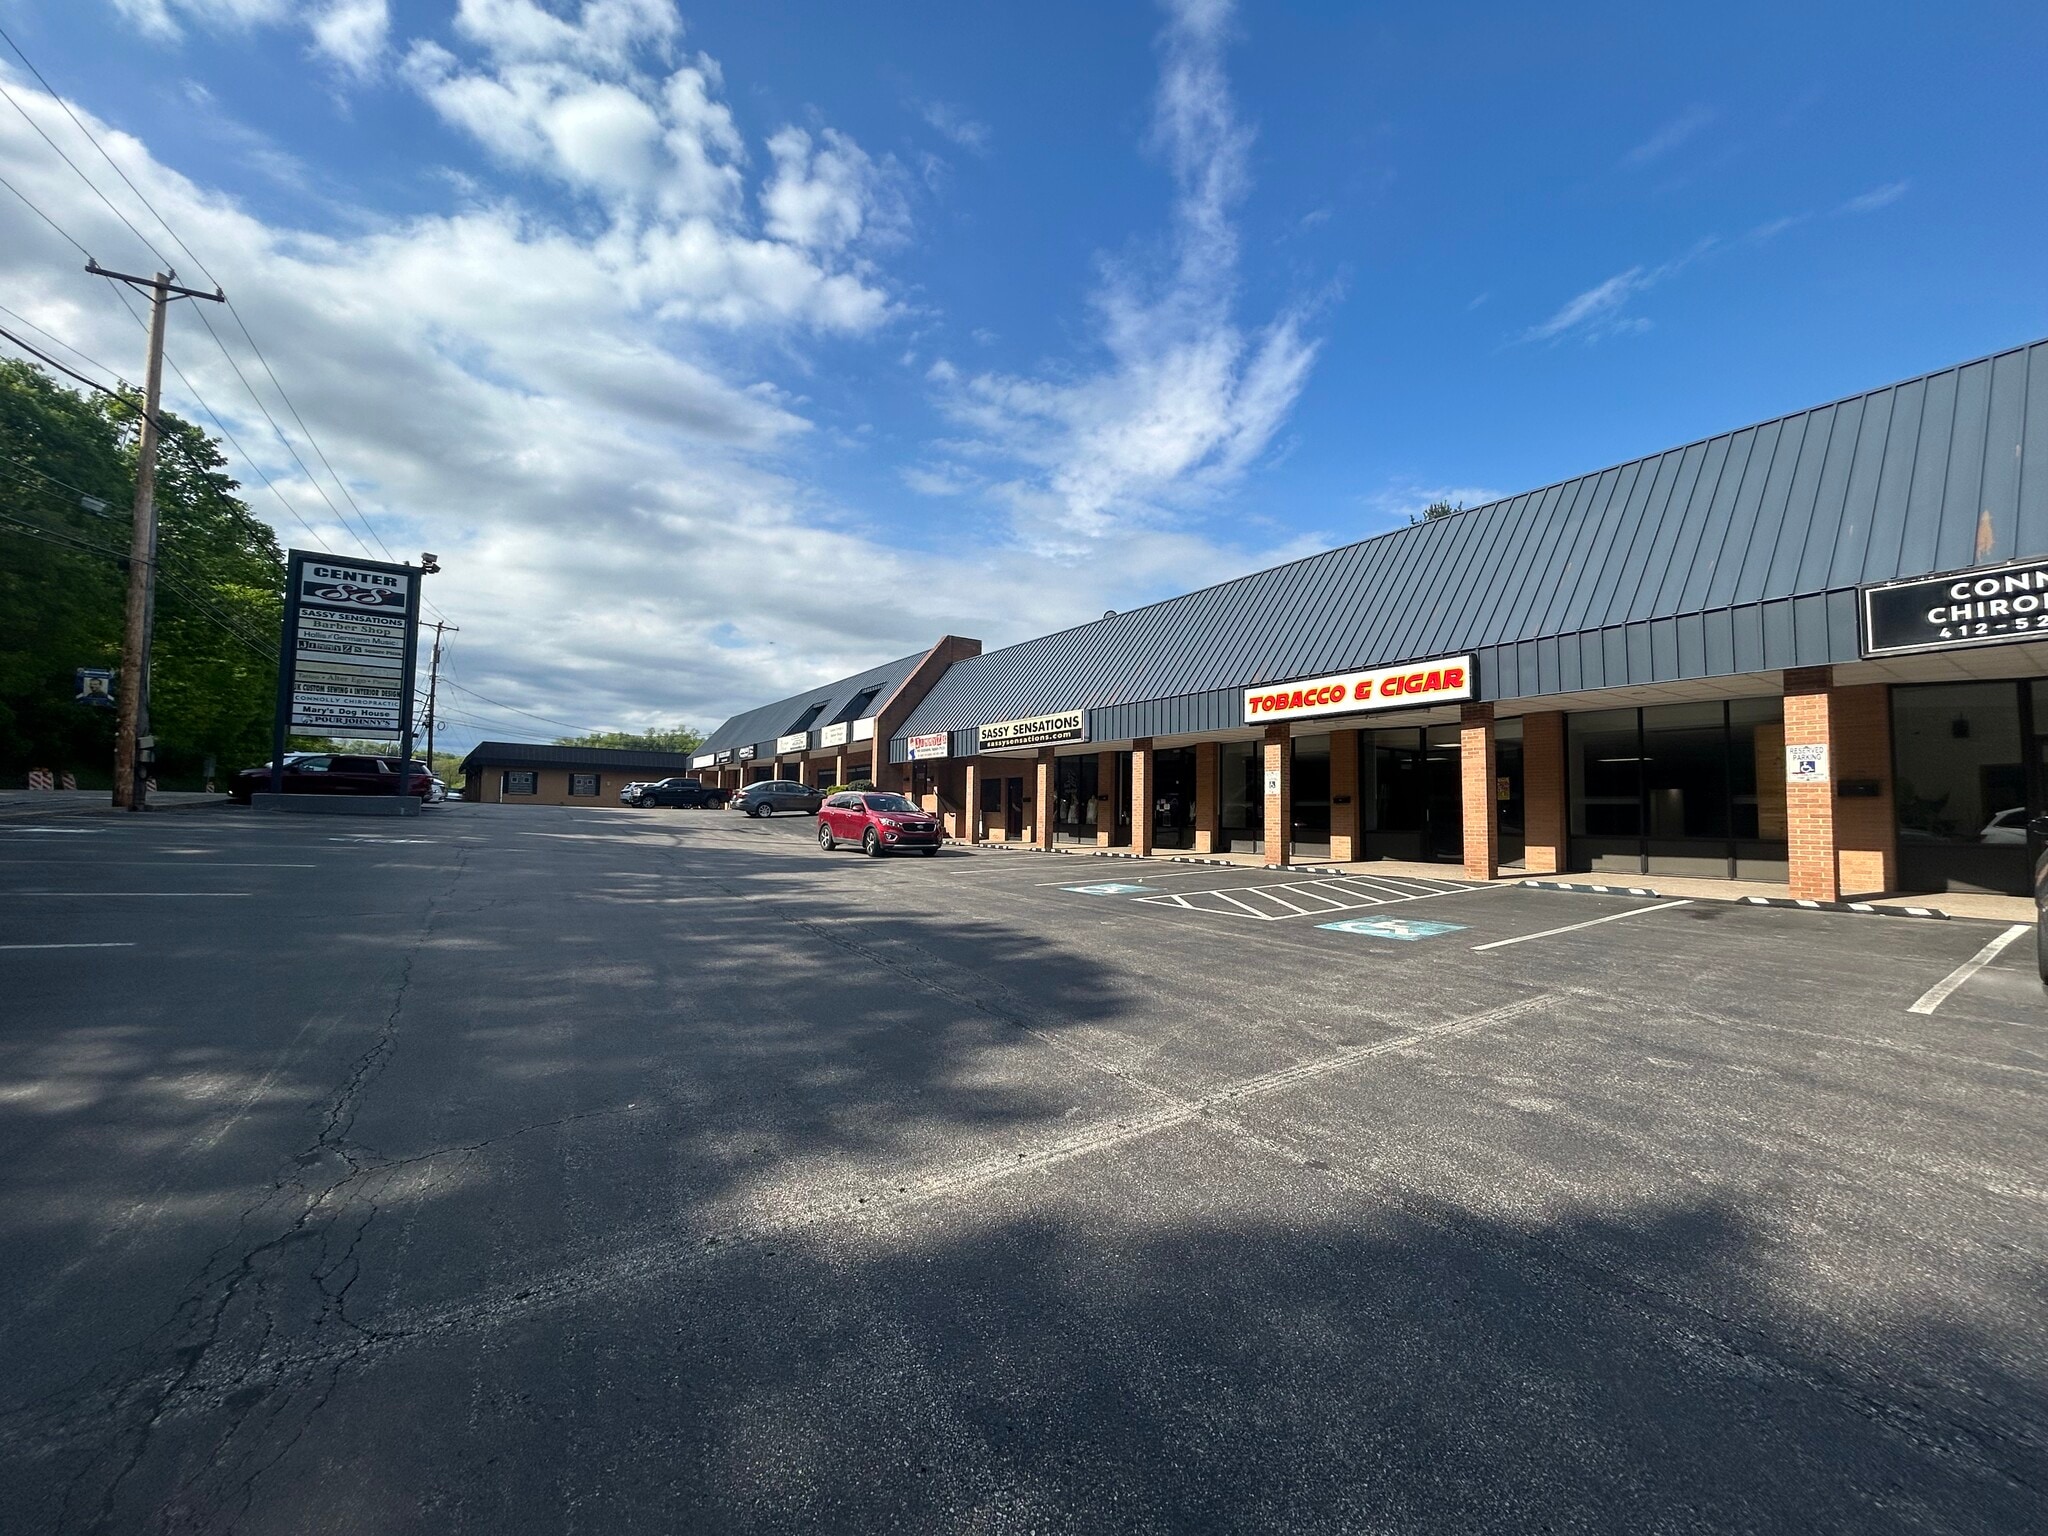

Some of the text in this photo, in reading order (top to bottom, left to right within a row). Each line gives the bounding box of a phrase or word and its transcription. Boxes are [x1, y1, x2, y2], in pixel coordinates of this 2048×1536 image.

[314, 567, 397, 587] CENTER
[1927, 592, 2048, 624] CHIRO
[301, 609, 403, 626] SASSY SENSATIONS
[313, 621, 391, 637] Barber Shop
[303, 631, 327, 639] Hollis
[333, 633, 371, 643] Germann
[372, 637, 396, 646] Music
[327, 674, 348, 682] Alter
[351, 676, 367, 684] Ego
[303, 684, 325, 693] CUSTOM
[327, 685, 349, 694] SEWING
[354, 687, 380, 696] INTERIOR
[381, 689, 400, 698] DESIGN
[1249, 668, 1464, 713] TOBACCO & CIGAR
[294, 695, 399, 707] CONNOLLY CHIROPRACTIC
[302, 706, 390, 717] Mary's Dog House
[315, 716, 391, 726] POUR JOHNNY'S
[981, 715, 1080, 740] SASSY SENSATIONS
[986, 730, 1072, 748] sassysensations.com
[1790, 746, 1824, 755] RESERVED
[1792, 753, 1822, 761] PARKING
